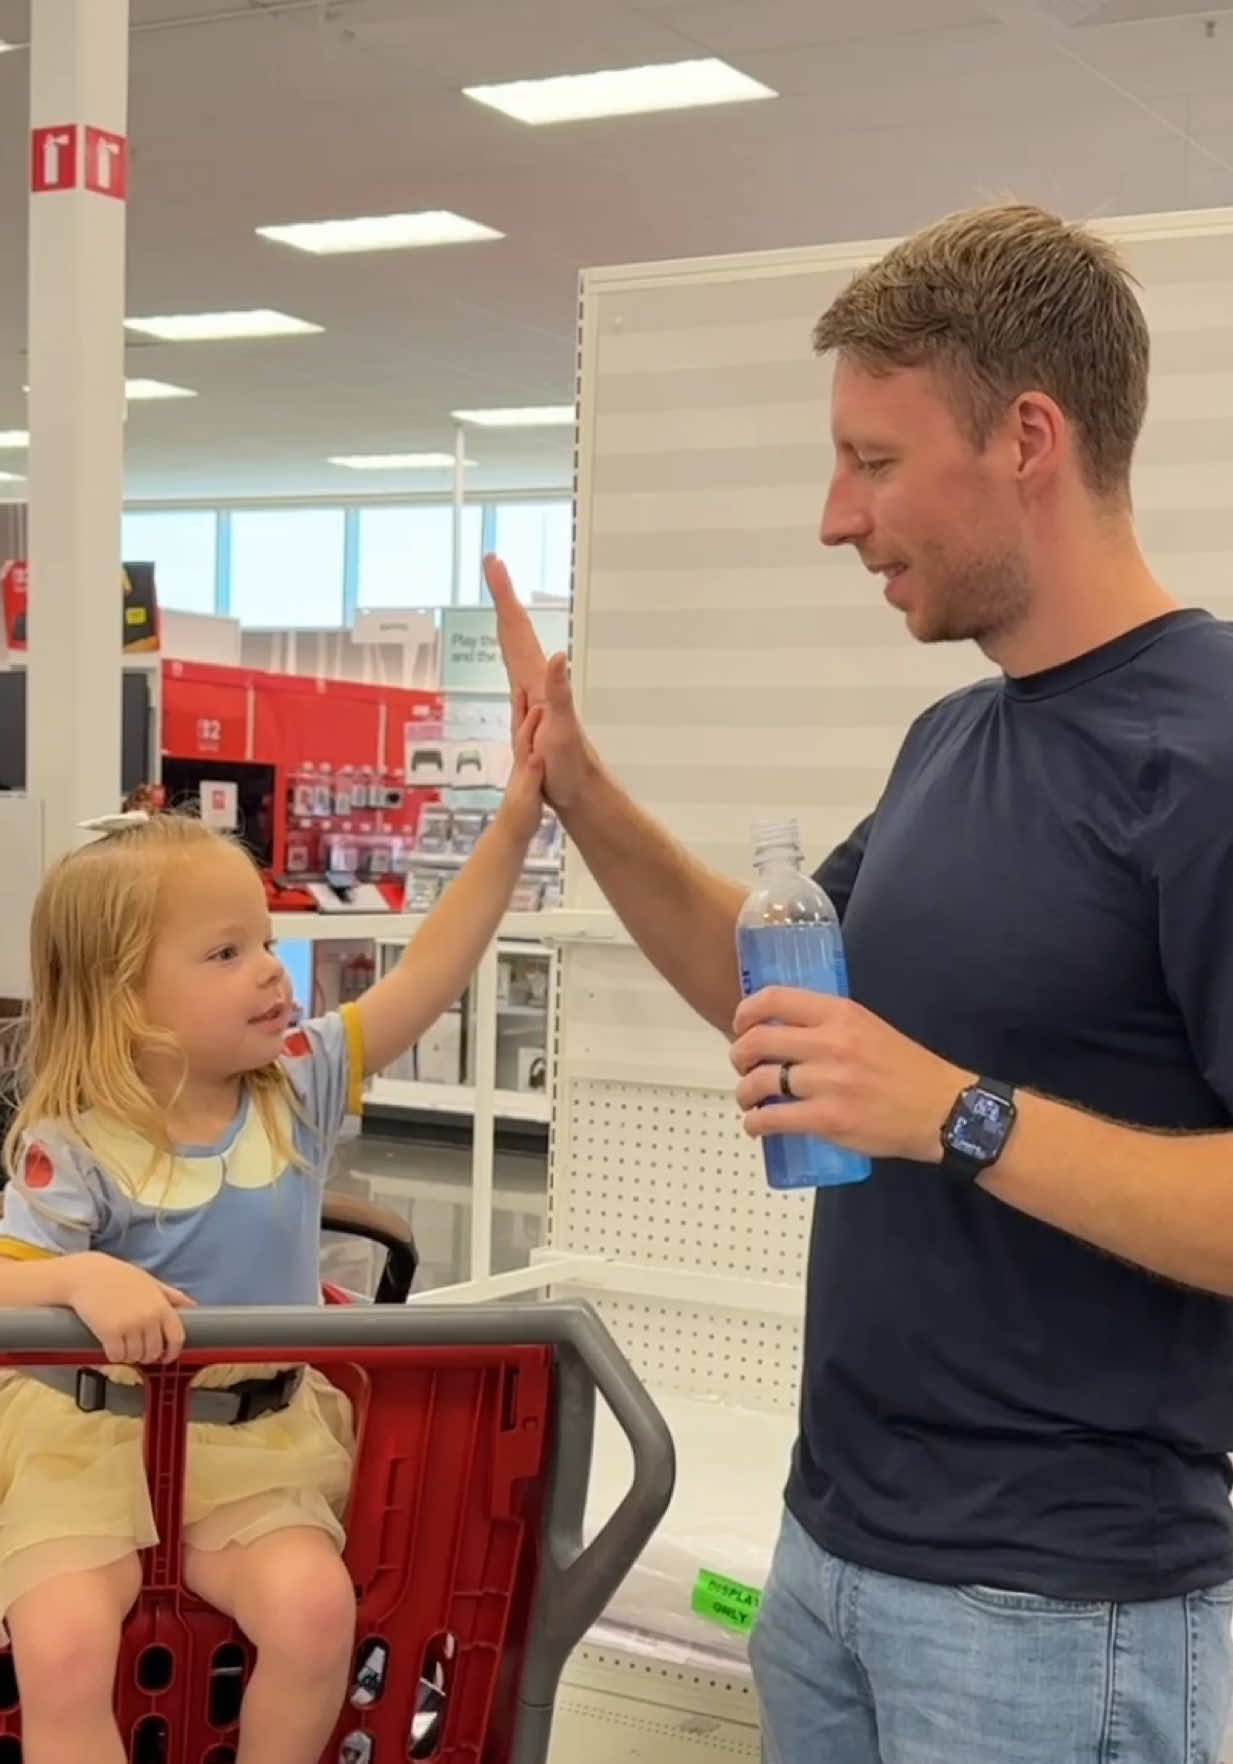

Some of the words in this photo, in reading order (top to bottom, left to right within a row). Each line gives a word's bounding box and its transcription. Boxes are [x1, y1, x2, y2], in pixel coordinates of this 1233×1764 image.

[451, 632, 476, 648] Play
[451, 649, 474, 663] and
[712, 1600, 749, 1625] ONLY
